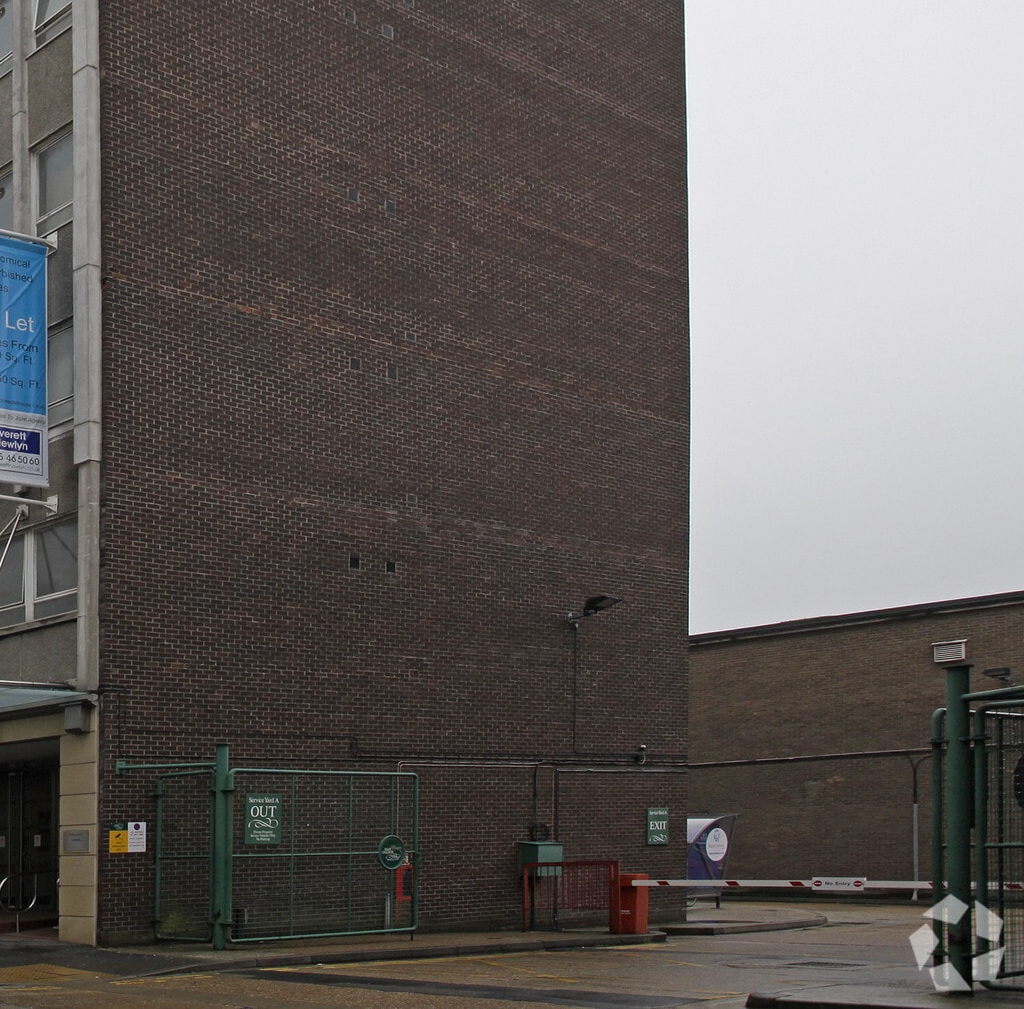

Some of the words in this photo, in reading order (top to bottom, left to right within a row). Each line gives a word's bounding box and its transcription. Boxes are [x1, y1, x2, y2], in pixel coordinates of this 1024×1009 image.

[5, 311, 35, 333] Let
[11, 340, 39, 353] From
[6, 455, 17, 463] 46
[17, 456, 28, 465] 50
[29, 458, 40, 466] 60
[250, 805, 278, 818] OUT
[649, 821, 667, 830] EXIT
